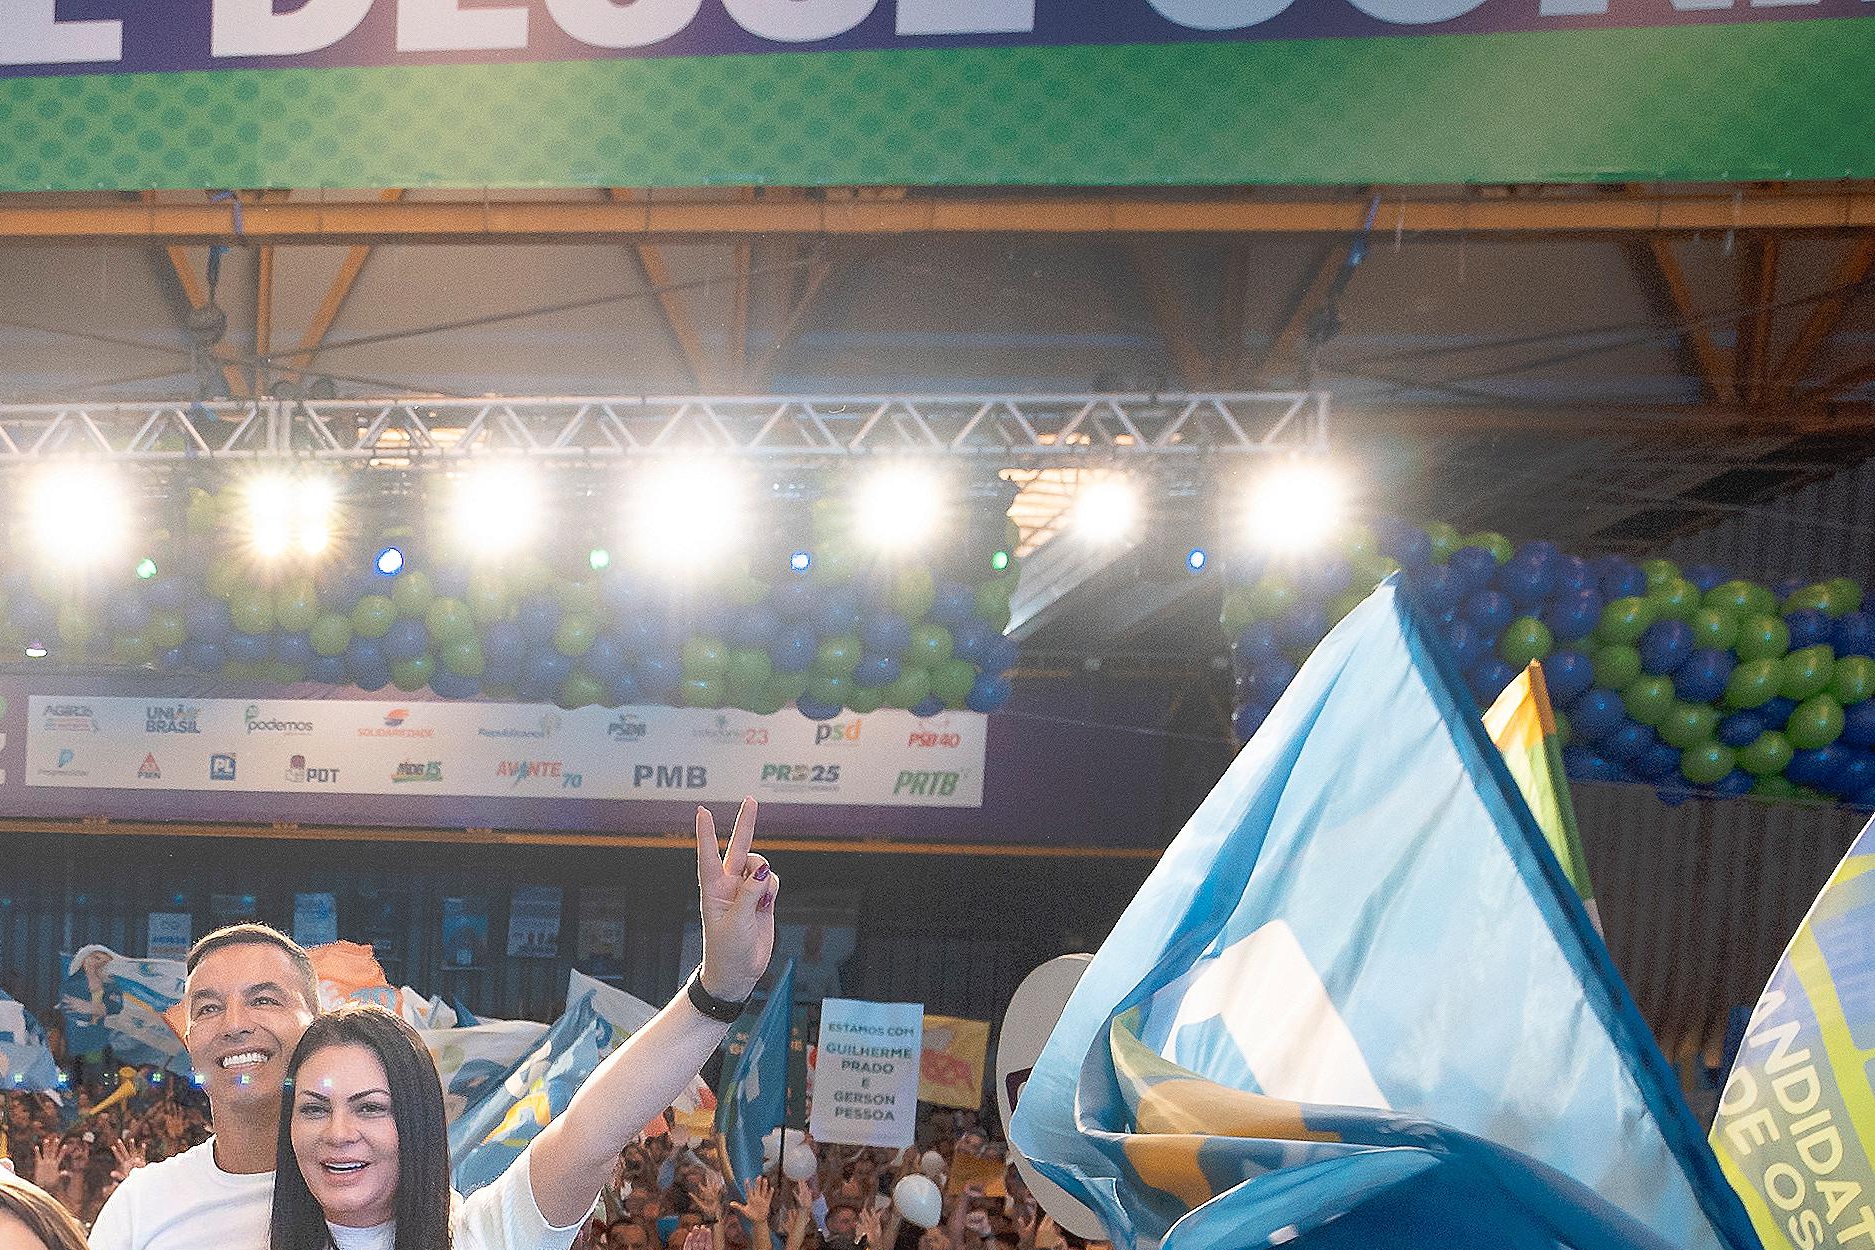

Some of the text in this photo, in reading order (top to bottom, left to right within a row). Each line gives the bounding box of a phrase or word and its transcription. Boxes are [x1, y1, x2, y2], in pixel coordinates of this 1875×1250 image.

[146, 721, 201, 734] BRASIL
[246, 718, 314, 735] podemos
[814, 718, 862, 745] psd
[745, 728, 769, 745] 23
[306, 768, 340, 783] PDT
[633, 764, 707, 789] PMB
[893, 769, 960, 796] PRTB
[828, 1023, 915, 1036] ESTAMOS COM
[826, 1043, 912, 1059] GUILHERME
[840, 1060, 895, 1075] PRADO
[833, 1089, 896, 1106] GERSON
[834, 1106, 895, 1121] PESSOA
